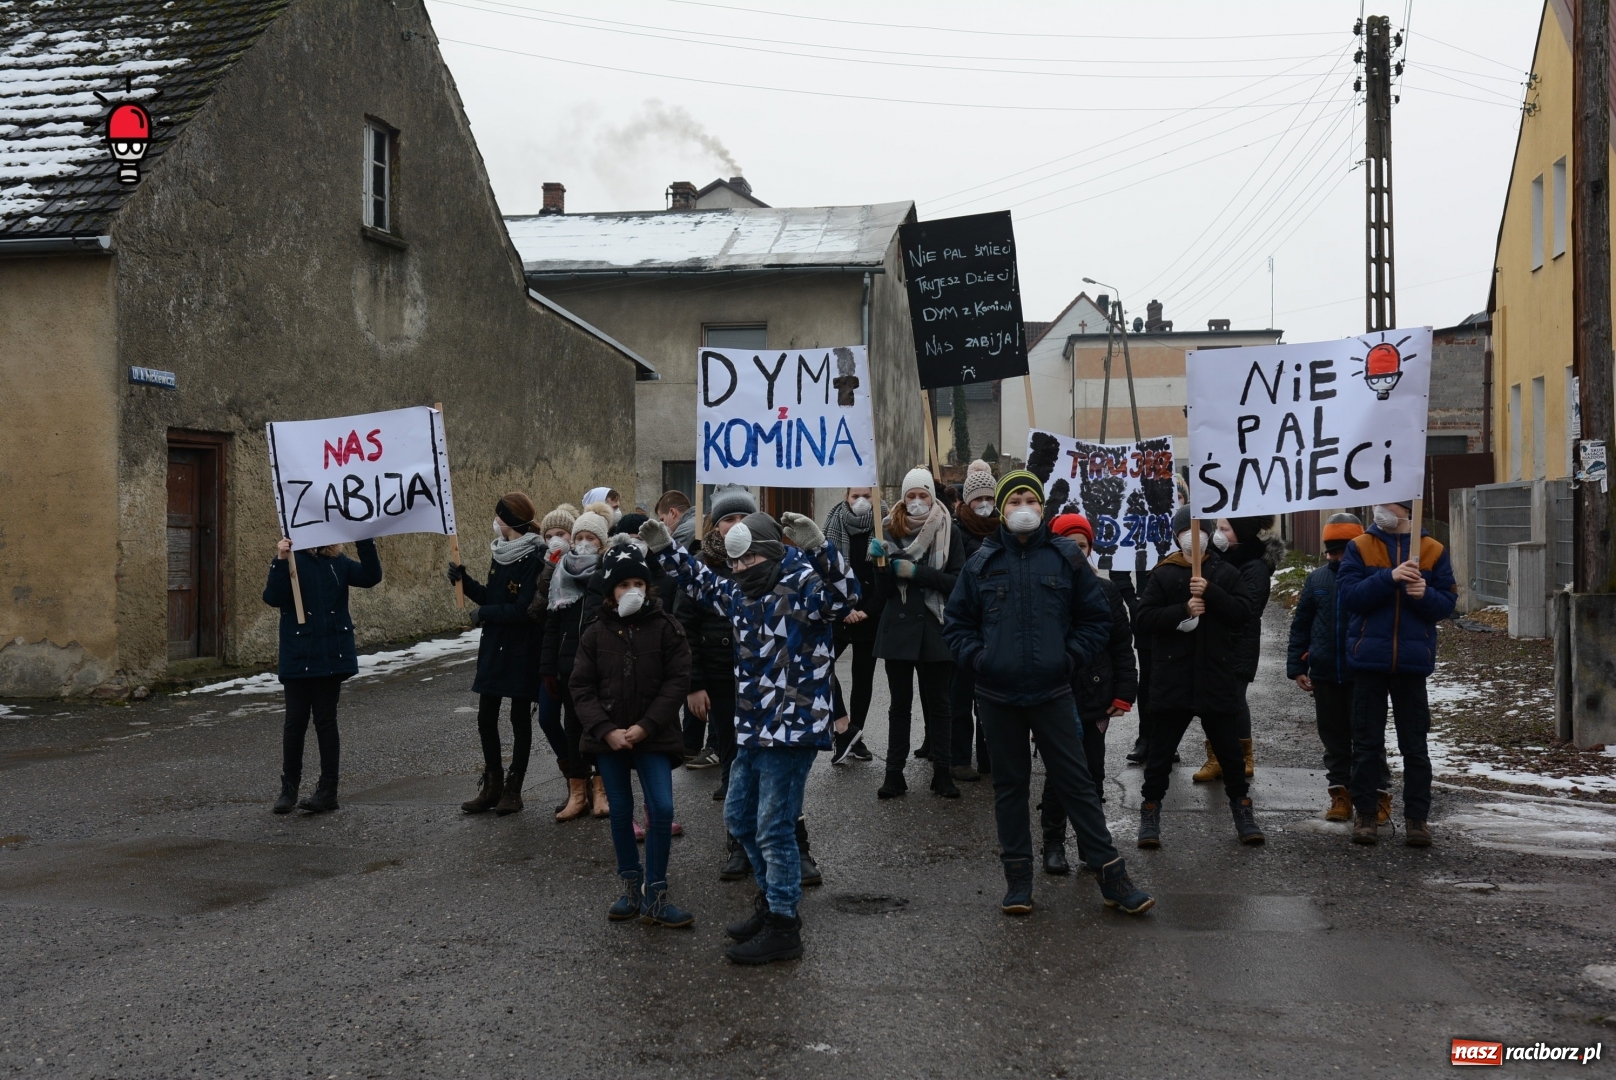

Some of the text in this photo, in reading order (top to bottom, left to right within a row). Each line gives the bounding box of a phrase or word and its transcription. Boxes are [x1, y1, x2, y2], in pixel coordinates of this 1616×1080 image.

[943, 248, 967, 260] PAL
[922, 306, 958, 322] DYM
[925, 334, 954, 356] NAS
[701, 350, 830, 410] DYM
[323, 428, 383, 470] NAS
[703, 415, 863, 471] KOMINA
[1237, 405, 1340, 454] PAL
[287, 472, 437, 528] ZABIJA
